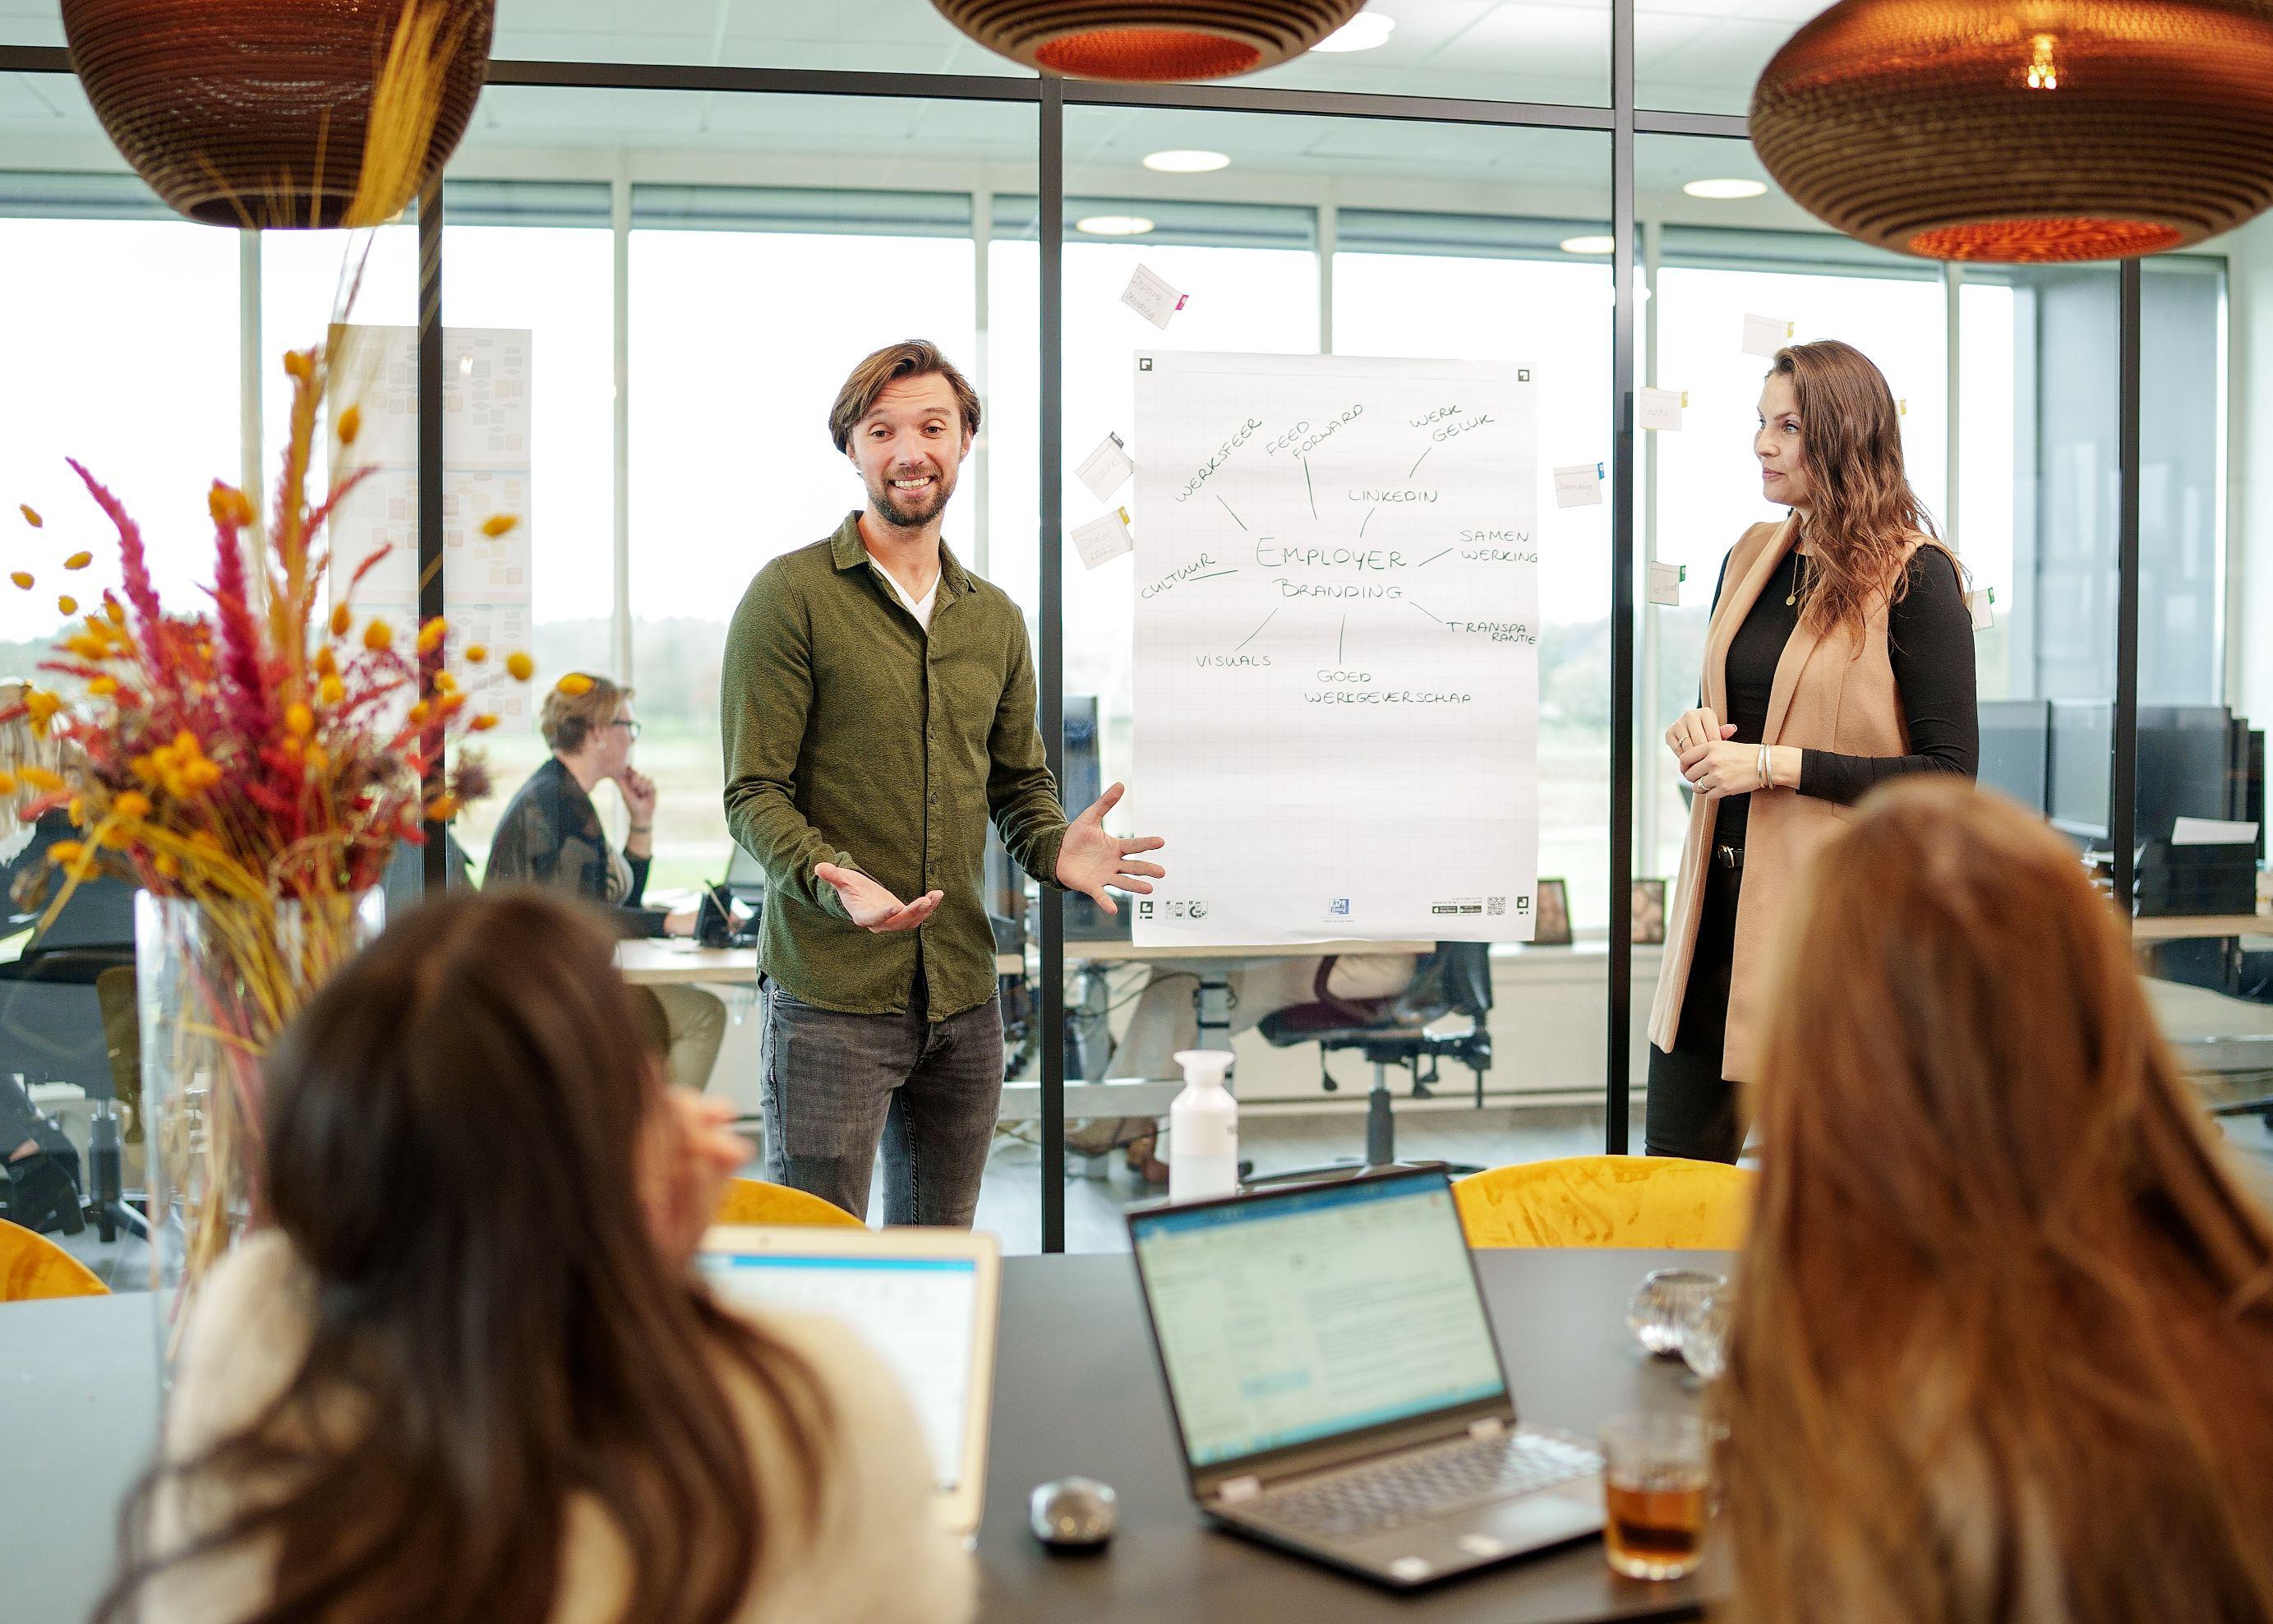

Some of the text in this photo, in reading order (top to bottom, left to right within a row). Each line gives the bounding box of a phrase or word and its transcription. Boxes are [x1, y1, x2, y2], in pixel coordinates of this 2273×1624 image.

[1409, 404, 1463, 428] WERK
[1266, 421, 1310, 457] FEED
[1292, 404, 1364, 460] FORWARD
[1174, 418, 1262, 504] WERKSFEER
[1348, 489, 1438, 503] LINKEDIN
[1459, 530, 1530, 542] SAMEN
[1256, 537, 1408, 571] EMPLOYER
[1460, 549, 1538, 564] WERKING
[1141, 552, 1217, 600] CULTUUR
[1272, 578, 1404, 599] BRANDING
[1445, 621, 1527, 634] TRANSPA
[1491, 631, 1538, 645] RANTIE
[1316, 670, 1372, 683] GOED
[1304, 690, 1472, 704] WERKGEVERSCHAP
